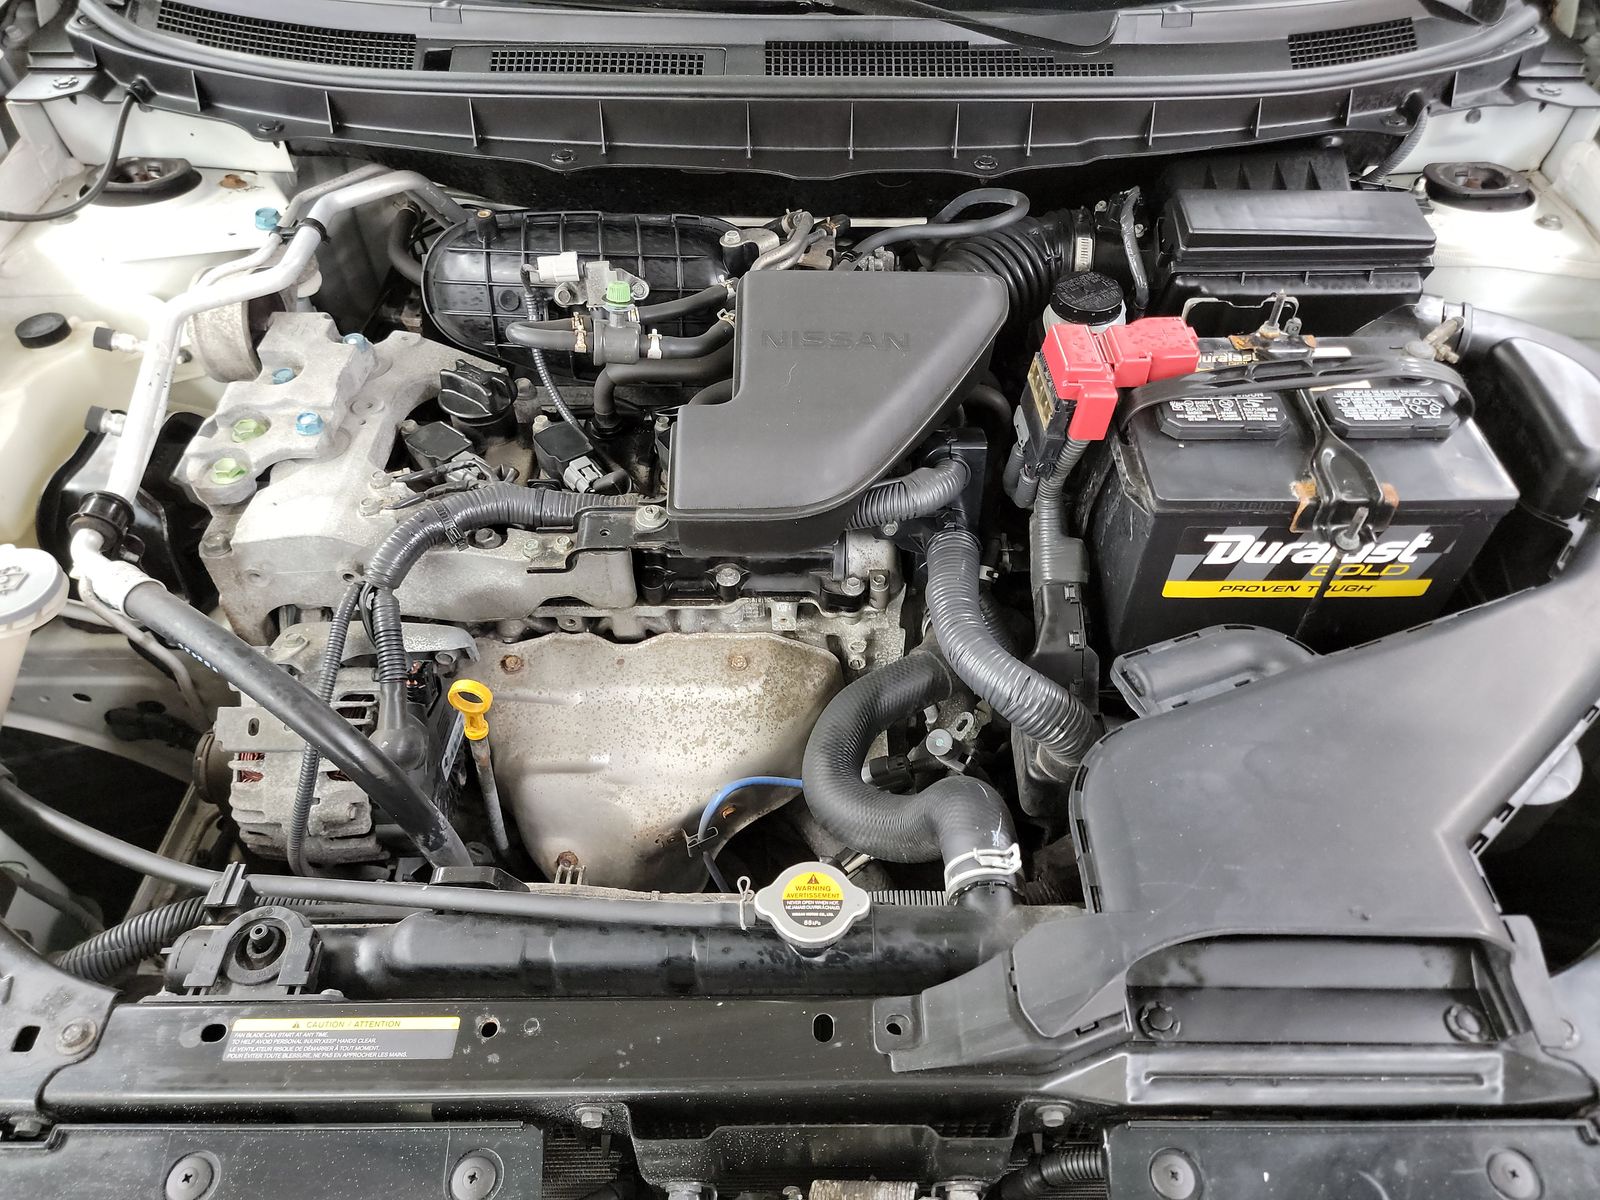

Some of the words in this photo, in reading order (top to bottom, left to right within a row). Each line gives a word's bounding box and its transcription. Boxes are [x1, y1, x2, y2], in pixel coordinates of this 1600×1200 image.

[760, 330, 910, 351] NISSAN
[1198, 351, 1260, 363] uralast
[1310, 564, 1410, 576] GOLD
